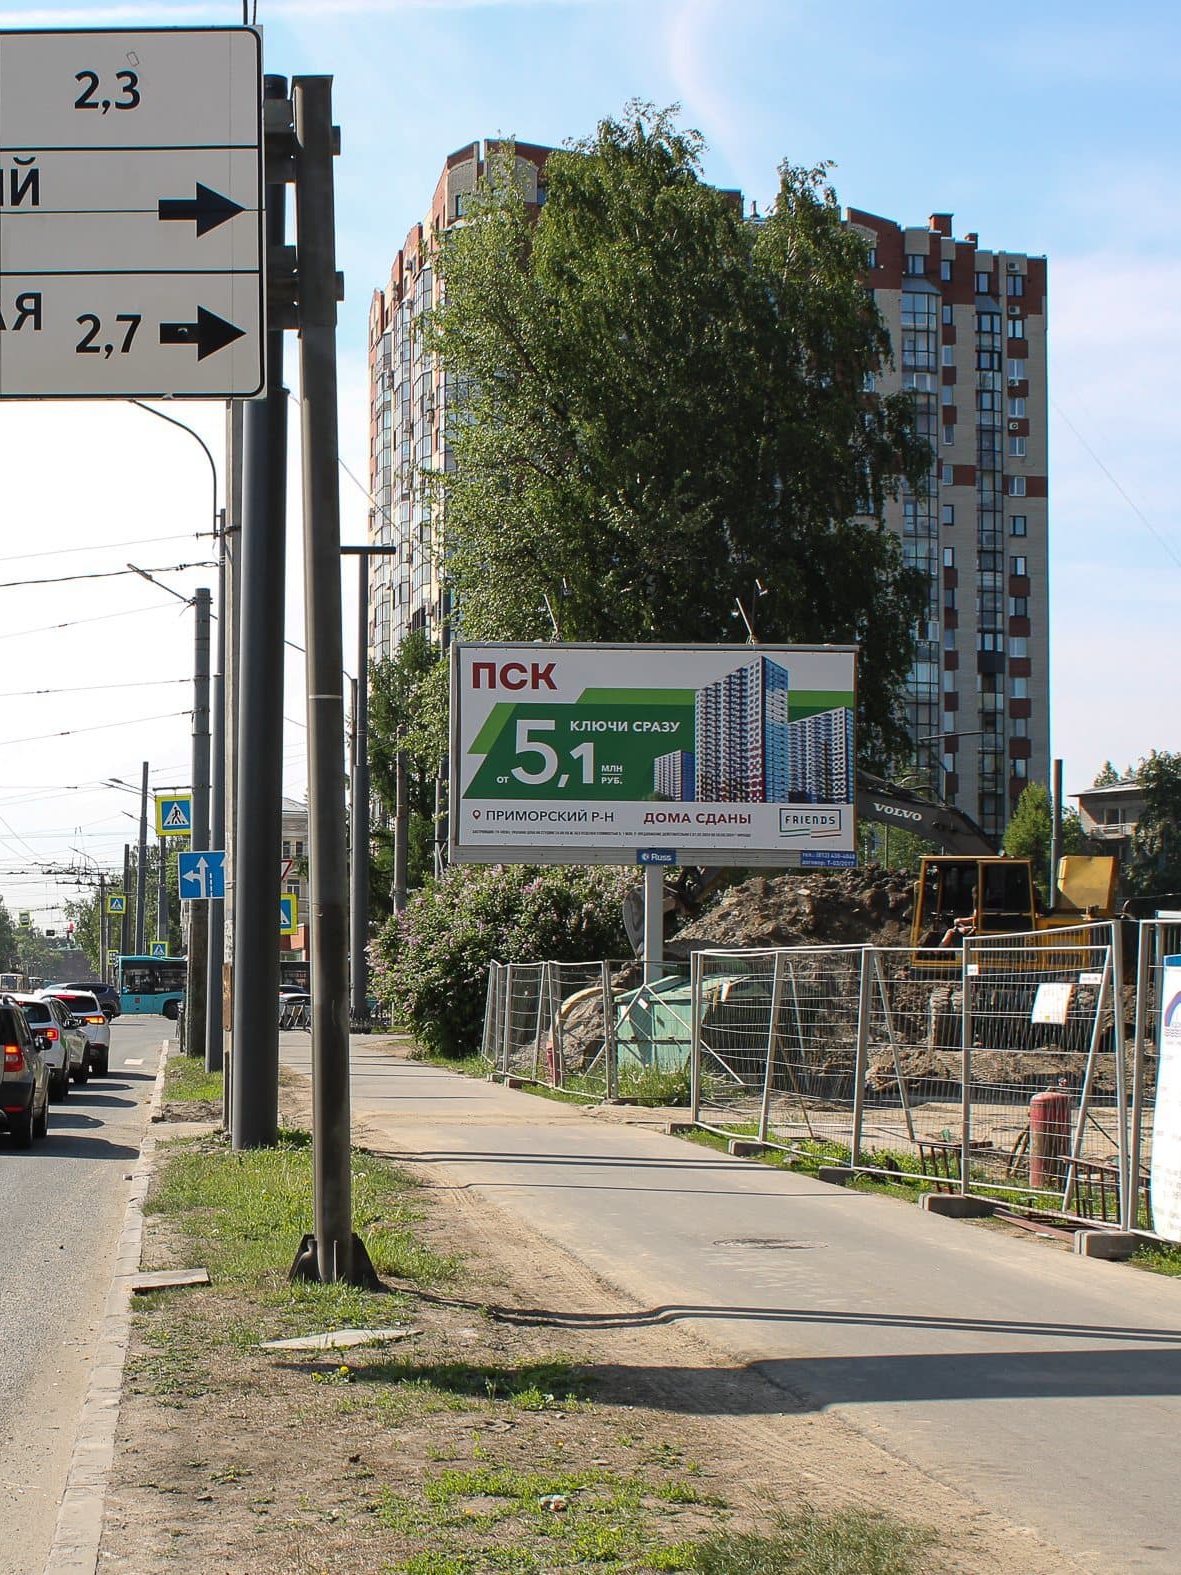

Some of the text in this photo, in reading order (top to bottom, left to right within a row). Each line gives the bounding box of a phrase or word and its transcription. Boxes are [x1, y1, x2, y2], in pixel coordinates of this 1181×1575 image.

[75, 71, 140, 111] 2,3
[76, 314, 141, 356] 2,7
[472, 662, 557, 690] ПСК
[570, 721, 680, 733] КЛЮЧИ СРАЗУ
[511, 720, 594, 787] 5,1
[601, 765, 623, 773] МЛН
[601, 776, 623, 785] РУБ.
[486, 810, 614, 822] ПРИМОРСКИЙ Р-Н
[873, 802, 923, 822] VOLVO
[643, 813, 751, 826] ДОМА СДАНЫ
[785, 815, 836, 825] FRIENDS
[650, 853, 672, 861] Russ
